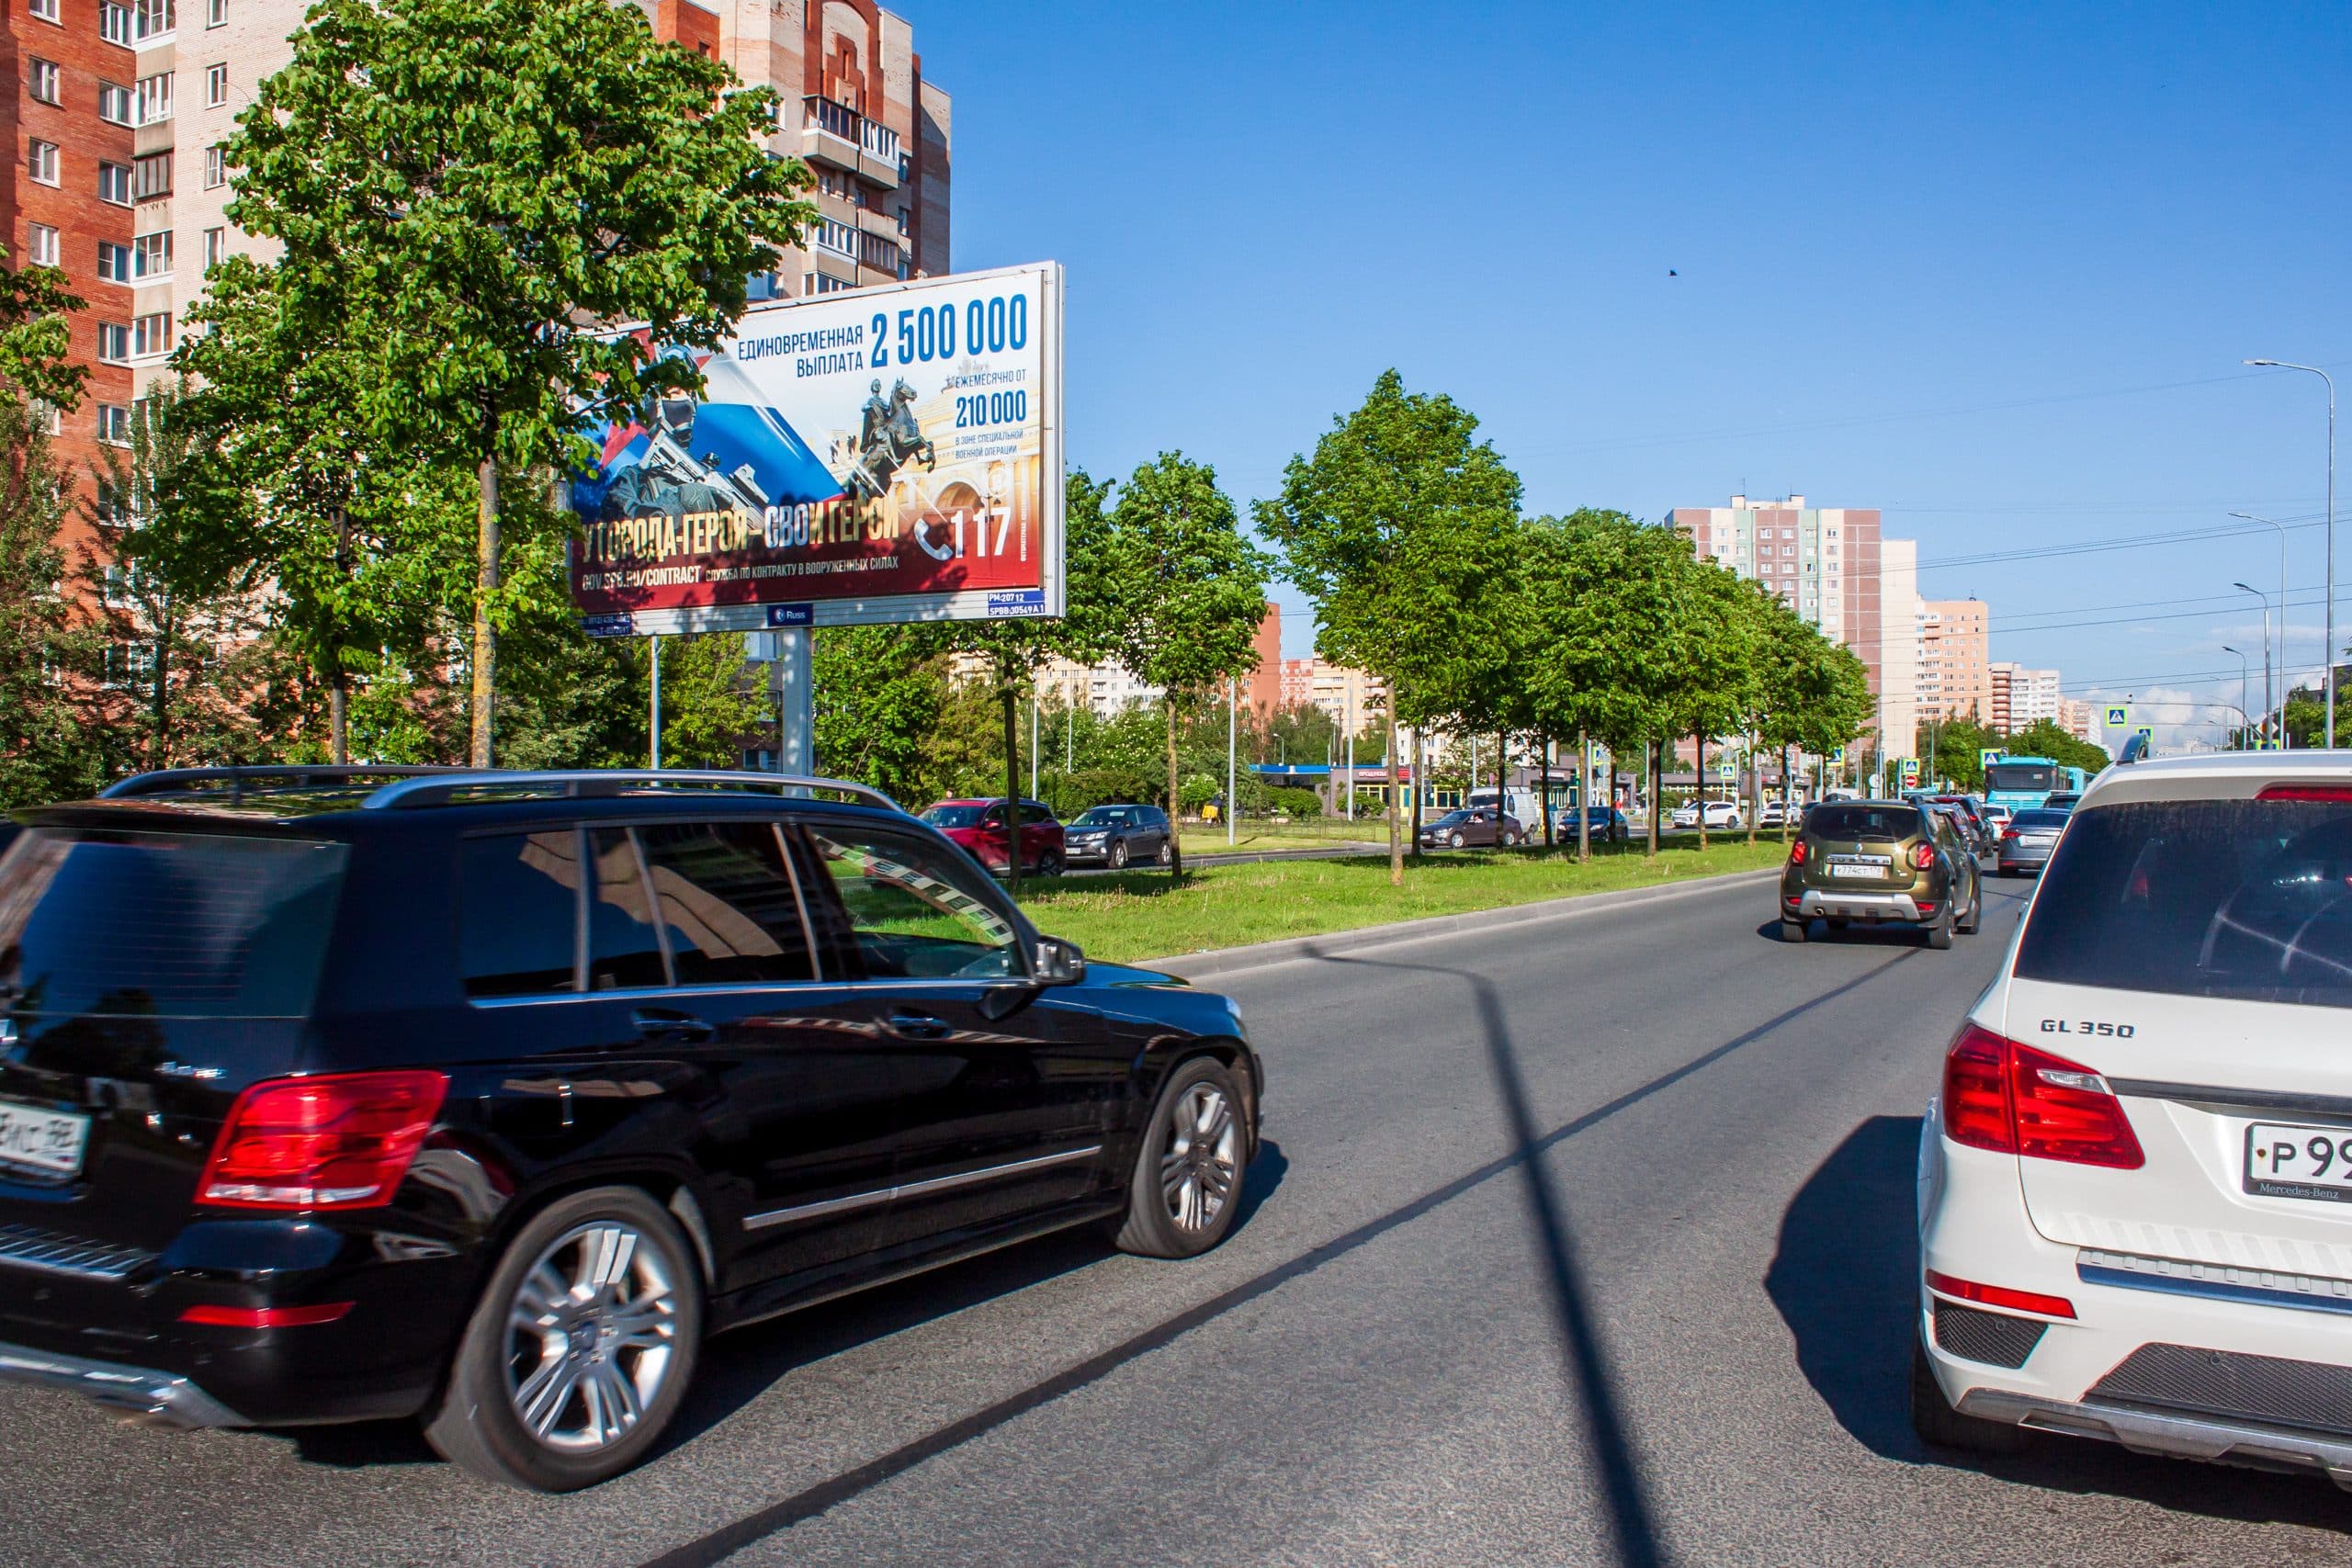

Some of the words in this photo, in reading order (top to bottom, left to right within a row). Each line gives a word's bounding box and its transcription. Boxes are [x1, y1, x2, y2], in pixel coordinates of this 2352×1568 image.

[738, 324, 863, 361] ЕДИНОВРЕМЕННАЯ
[871, 312, 888, 368] 2
[898, 303, 956, 365] 500
[967, 293, 1027, 355] 000
[797, 351, 864, 378] ВЫПЛАТА
[956, 371, 1014, 389] ЕЖЕМЕСЯЧНО
[1016, 369, 1026, 382] ОТ
[956, 394, 987, 428] 210
[990, 389, 1027, 424] 000
[956, 436, 960, 446] В
[961, 434, 977, 445] ЗОНЕ
[978, 428, 1023, 443] СПЕЦИАЛЬНОЙ
[956, 447, 983, 459] ВОЕННОЙ
[985, 446, 1017, 457] ОПЕРАЦИИ
[765, 502, 823, 548] СВОИ
[951, 507, 1011, 558] 117
[582, 565, 701, 591] GOV.SPB.RU/CONTRACT
[706, 568, 738, 581] СЛУЖБА
[741, 568, 751, 580] ПО
[752, 563, 797, 578] КОНТРАКТУ
[798, 562, 805, 575] В
[806, 558, 868, 575] ВООРУЖЕННЫХ
[870, 556, 899, 570] СИЛАХ
[2041, 1020, 2071, 1032] GL
[2078, 1021, 2134, 1038] 350
[2260, 1183, 2339, 1199] Mercedes-Benz
